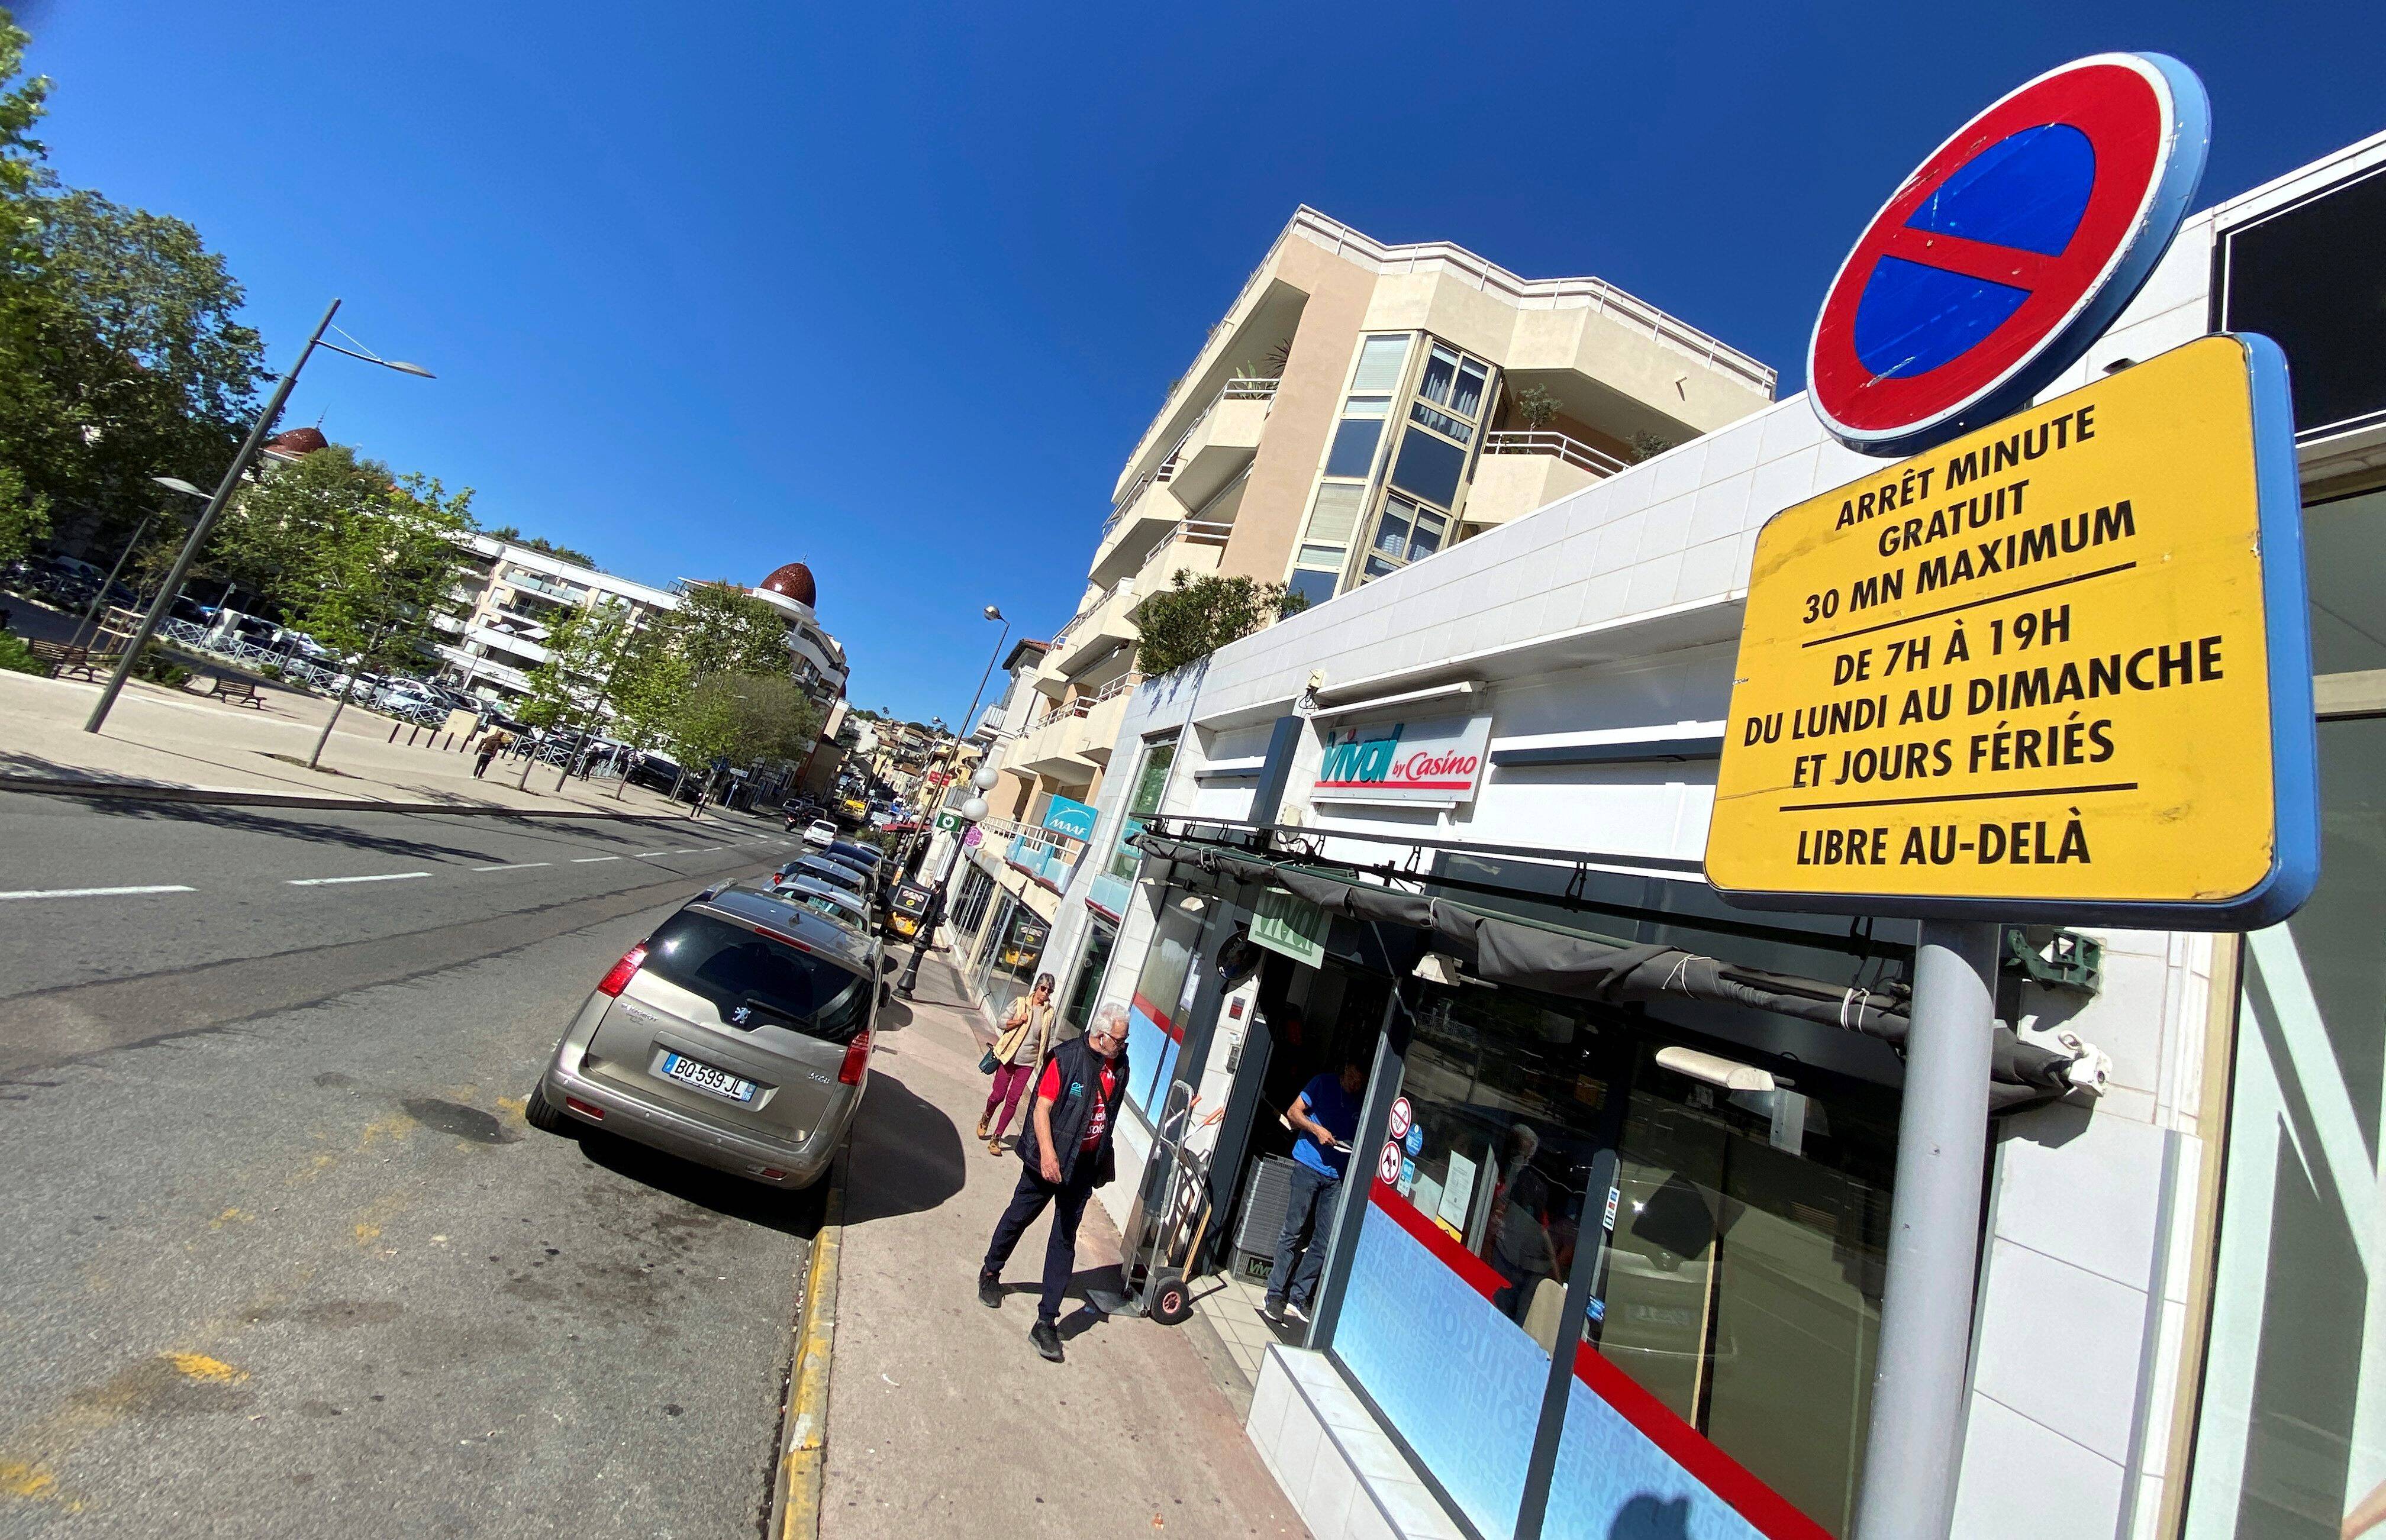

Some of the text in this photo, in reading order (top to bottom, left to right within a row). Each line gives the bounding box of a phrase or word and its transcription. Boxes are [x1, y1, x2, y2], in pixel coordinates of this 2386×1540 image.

[1836, 405, 2094, 531] ARRÊT MINUTE
[1878, 480, 2029, 556] GRATUIT
[1804, 501, 2134, 624] 30 MN MAXIMUM
[1834, 605, 2069, 686] DE 7H À 19H
[1745, 635, 2223, 746] DU LUNDI AU DIMANCHE
[1392, 761, 1405, 777] by
[1405, 750, 1477, 781] Casino
[1793, 711, 2114, 788] ET JOURS FÉRIÉS
[1049, 819, 1087, 835] MAAF
[1798, 807, 2090, 864] LIBRE AU-DELÀ
